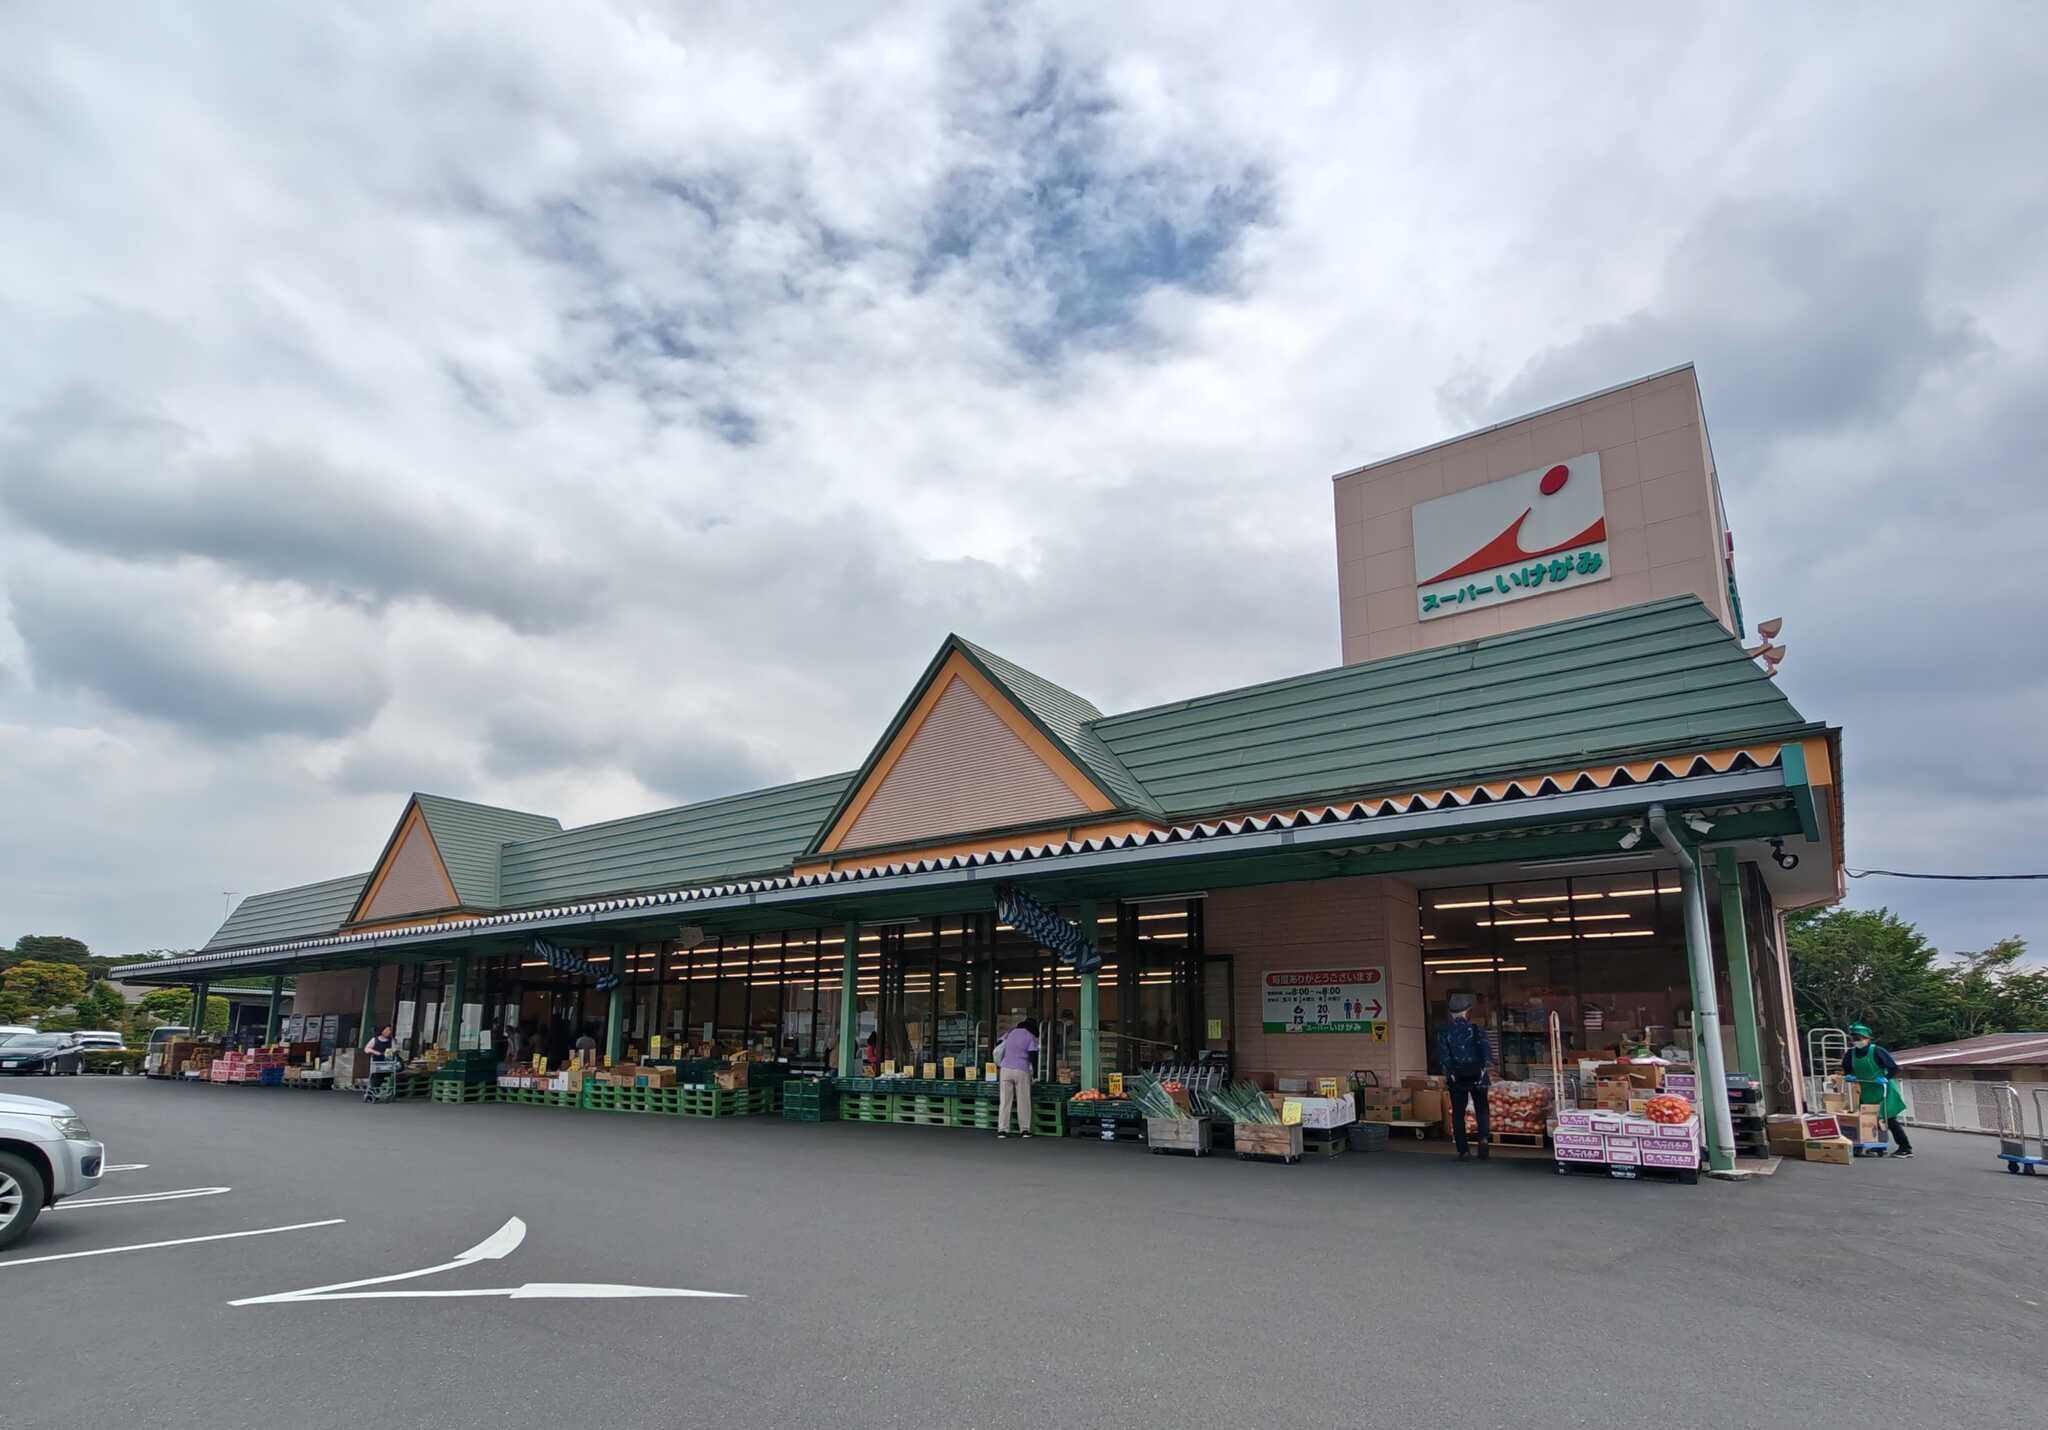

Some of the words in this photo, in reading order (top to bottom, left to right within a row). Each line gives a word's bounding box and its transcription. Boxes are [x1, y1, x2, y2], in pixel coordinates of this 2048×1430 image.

[1422, 551, 1603, 613] スーパーいけがみ
